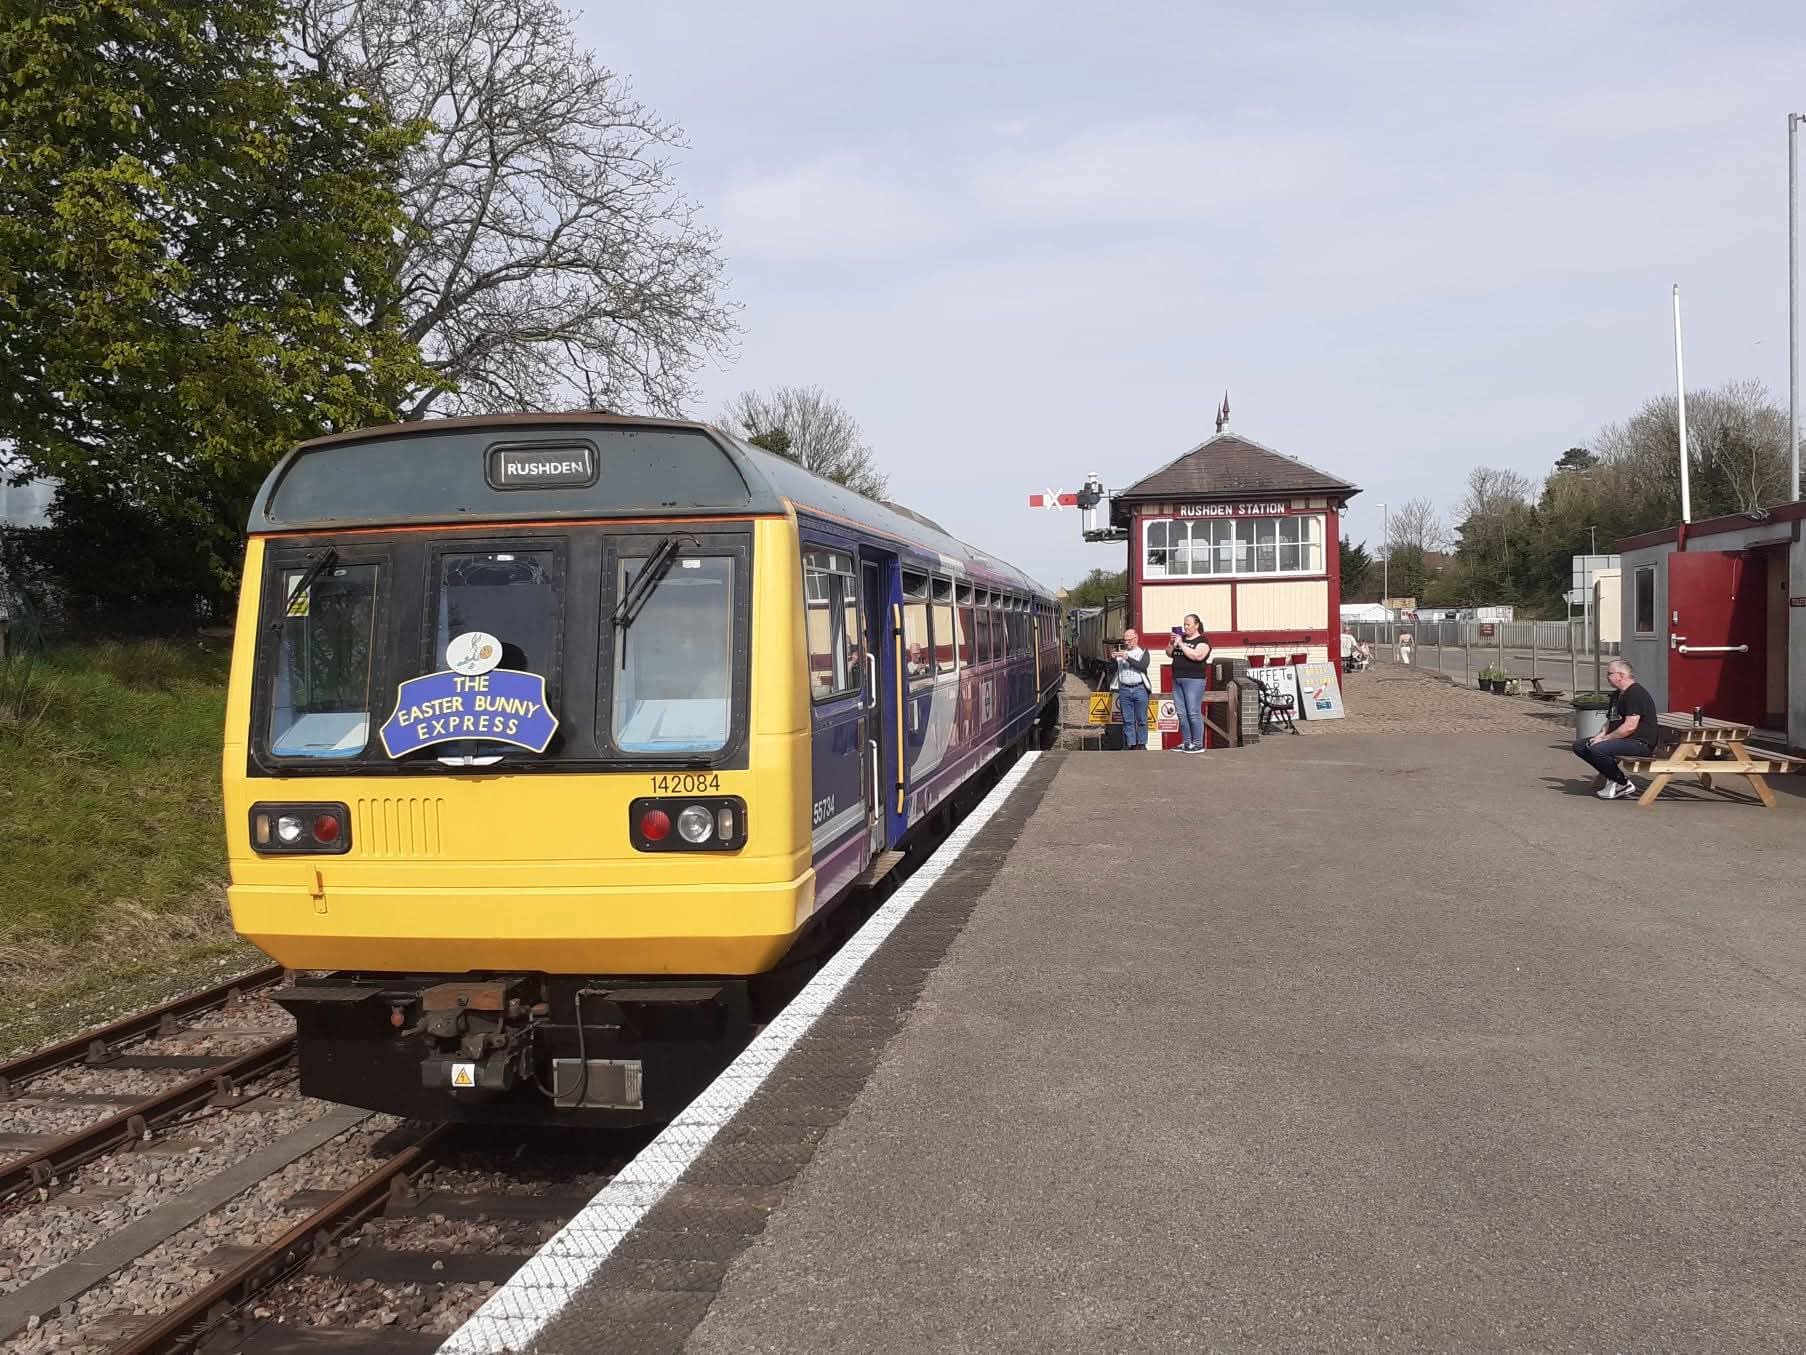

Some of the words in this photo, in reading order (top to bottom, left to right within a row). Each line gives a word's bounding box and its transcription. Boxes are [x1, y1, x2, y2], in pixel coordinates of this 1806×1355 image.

[507, 461, 584, 475] RUSHDEN
[1180, 504, 1233, 517] RUSHDEN
[1238, 503, 1285, 515] STATION
[453, 675, 490, 693] THE
[1246, 667, 1288, 682] UFFET
[398, 696, 464, 727] EASTER
[474, 695, 541, 719] BUNNY
[417, 715, 519, 740] EXPRESS
[650, 773, 721, 794] 142084
[813, 793, 835, 825] 55734
